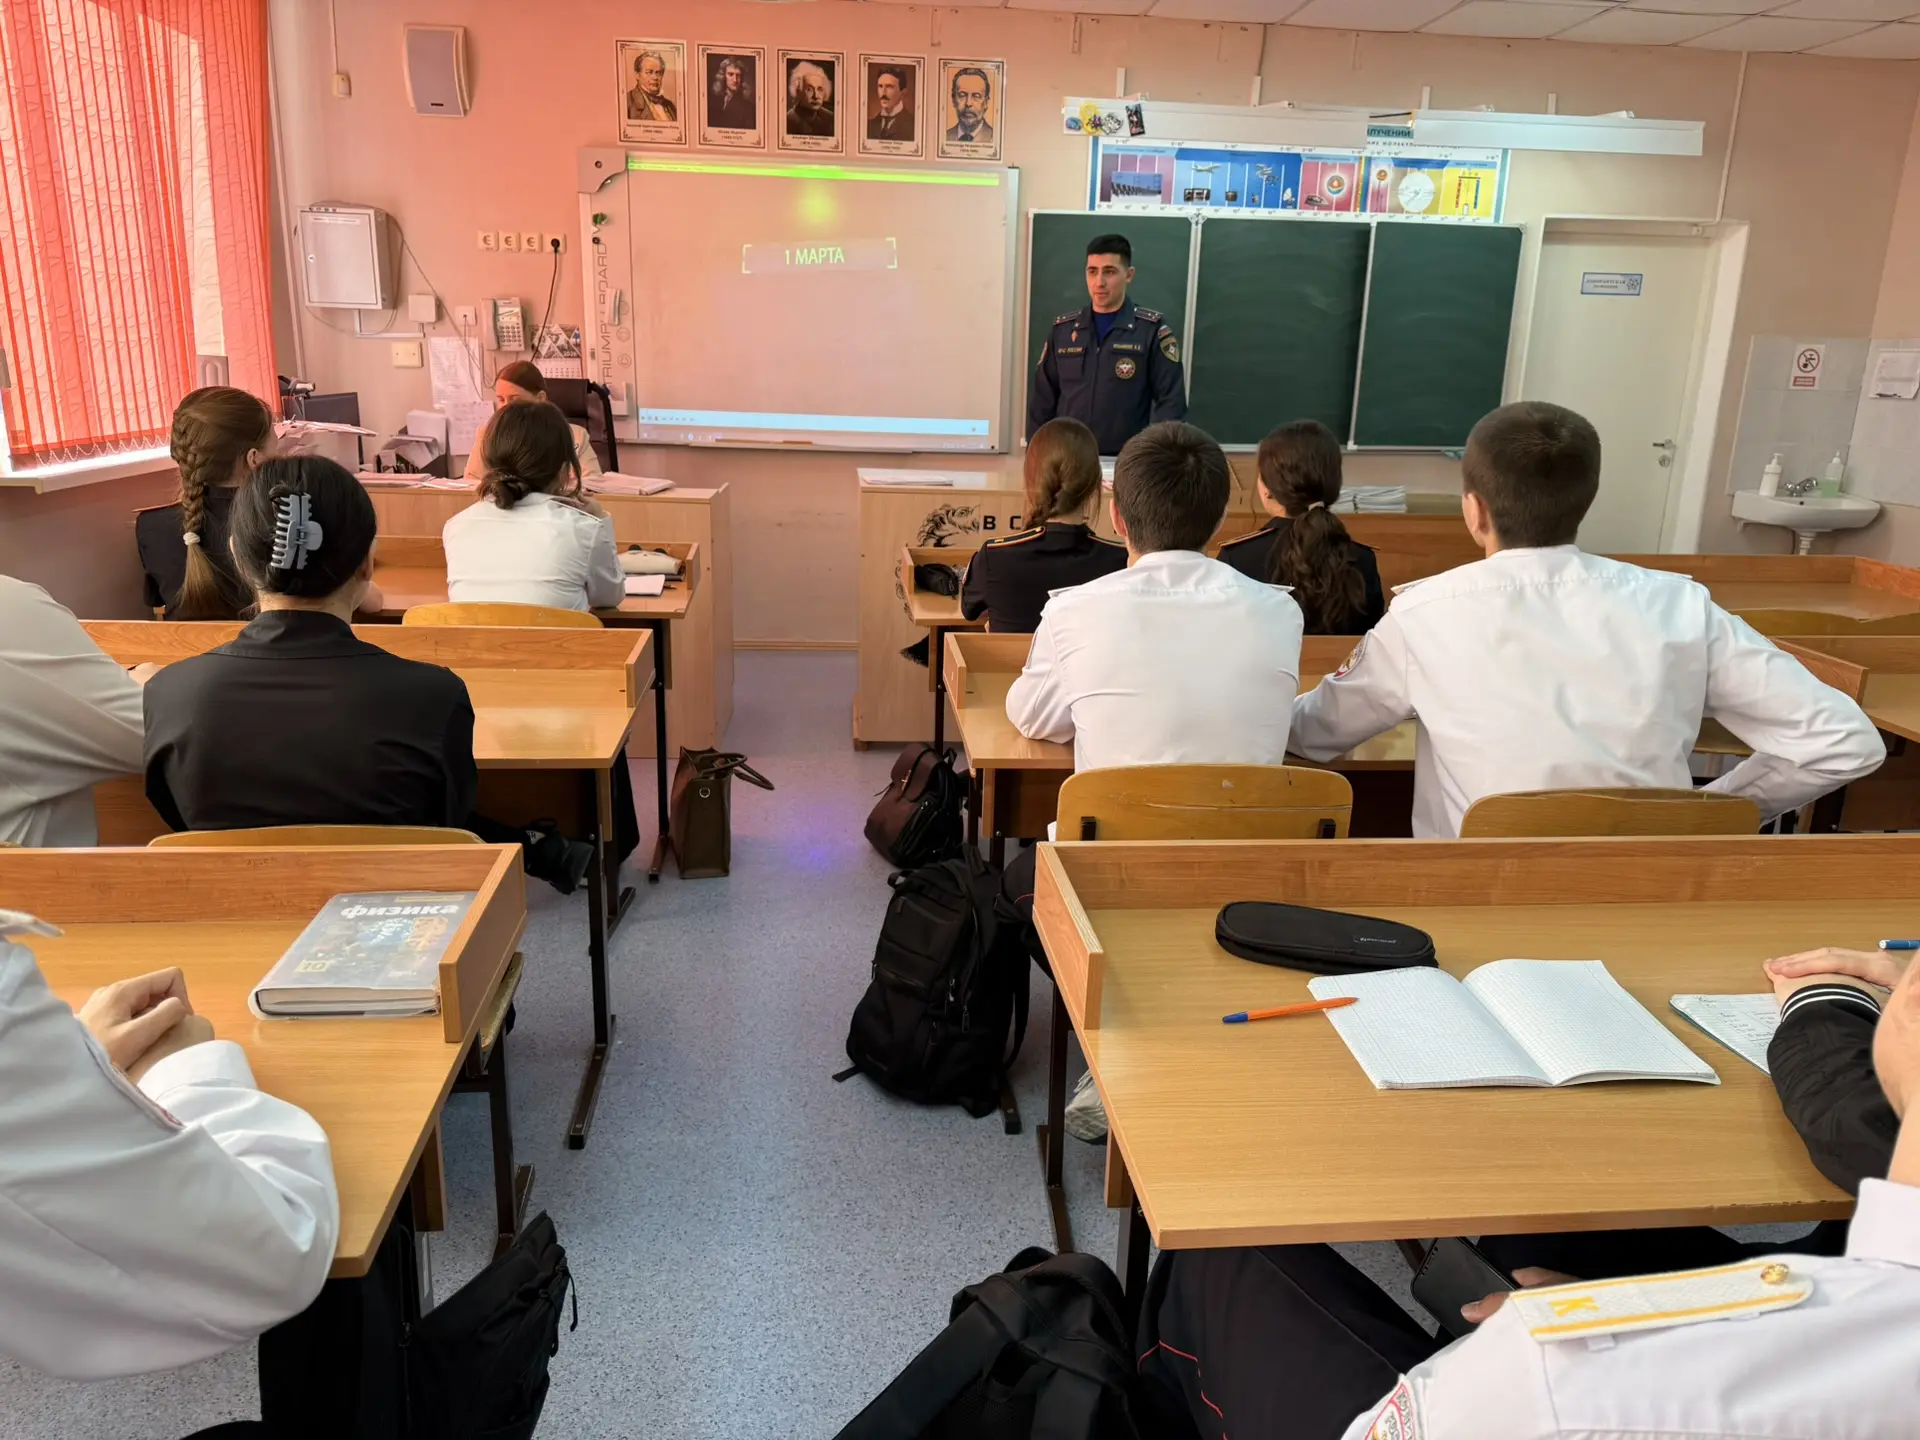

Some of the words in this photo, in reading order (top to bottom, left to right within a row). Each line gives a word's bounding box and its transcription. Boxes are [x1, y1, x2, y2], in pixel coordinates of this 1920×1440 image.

[785, 249, 790, 264] 1
[795, 247, 845, 264] МАРТА
[300, 961, 327, 971] 10
